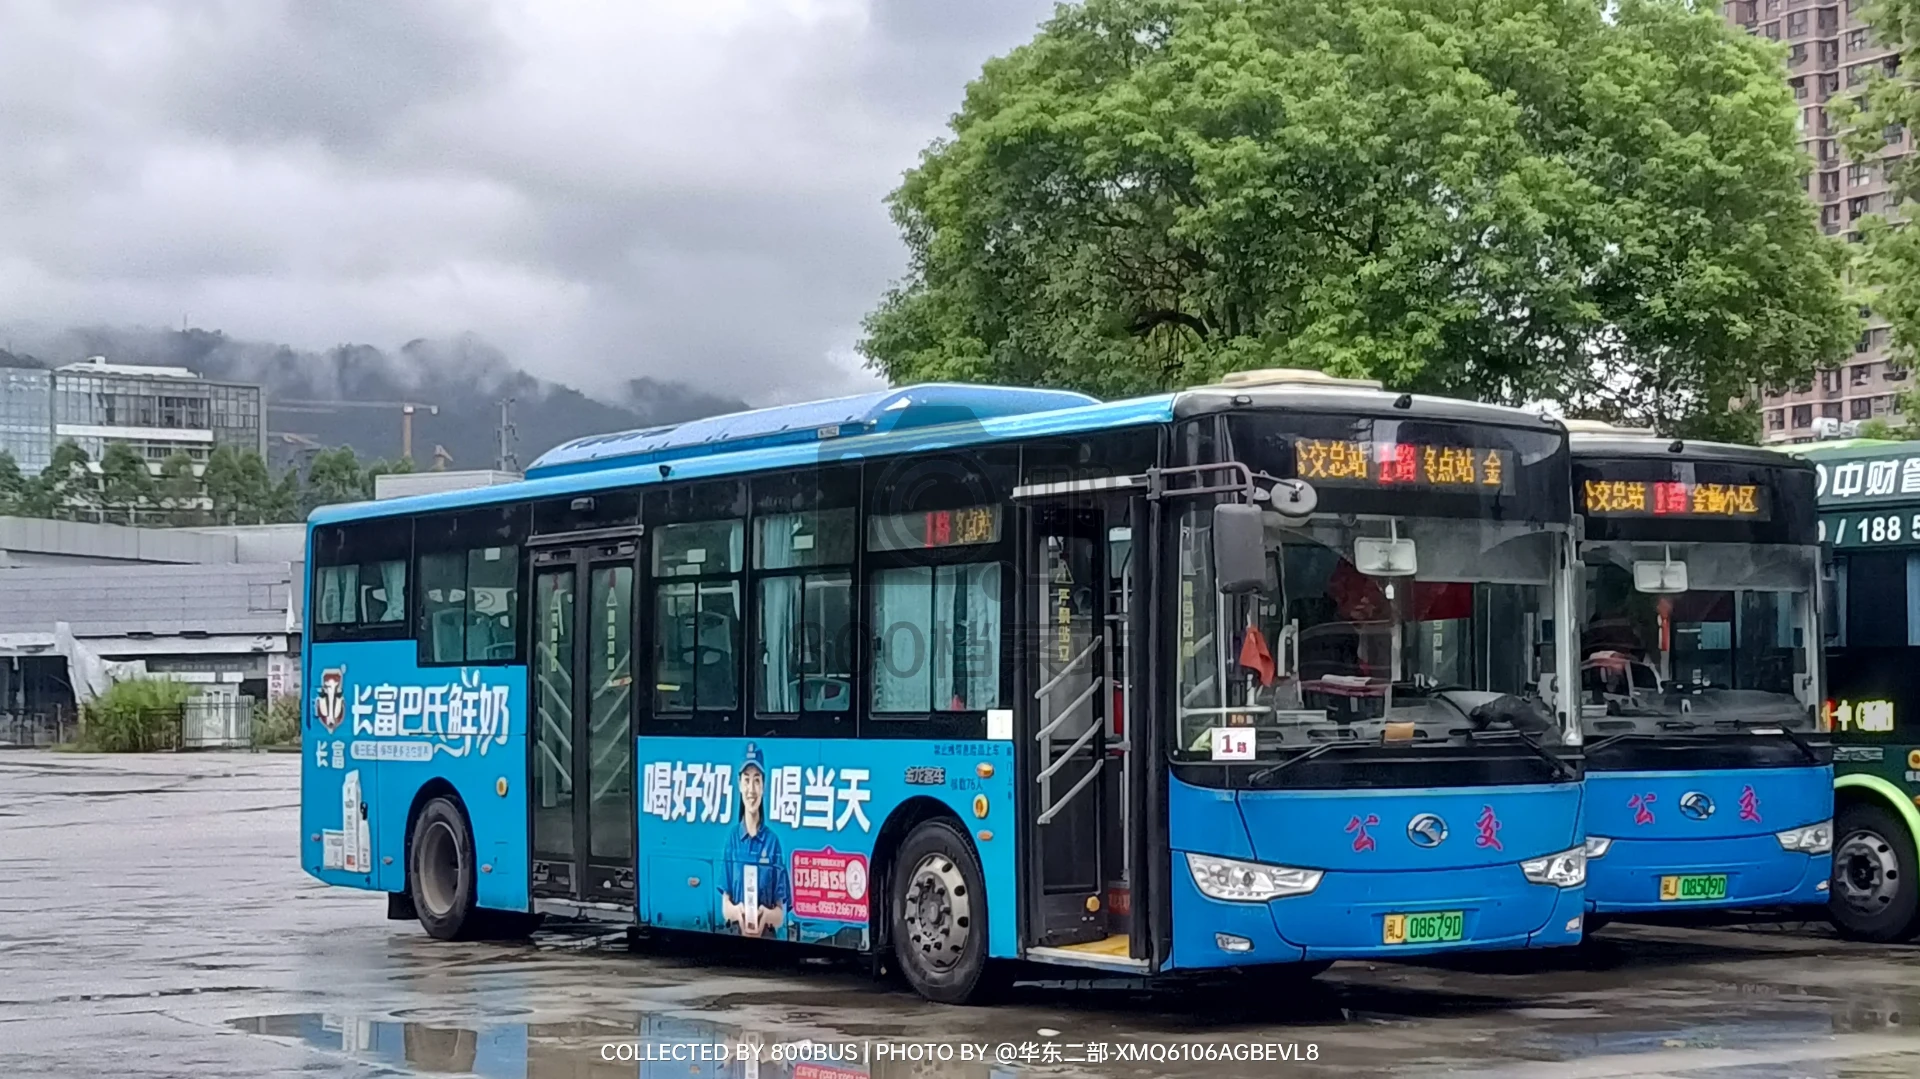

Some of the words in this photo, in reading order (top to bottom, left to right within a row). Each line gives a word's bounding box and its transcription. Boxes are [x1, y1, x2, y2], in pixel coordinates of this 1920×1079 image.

[1379, 443, 1416, 484] 1路
[1483, 448, 1501, 484] 金
[1654, 482, 1687, 515] 1路
[925, 510, 951, 548] 1路
[1857, 516, 1901, 542] 188
[351, 667, 510, 757] 长富巴氏鲜奶
[316, 740, 345, 769] 长富
[643, 761, 732, 824] 喝好奶
[769, 765, 871, 833] 喝当天
[1627, 792, 1657, 825] 公
[1738, 784, 1762, 824] 交
[1345, 815, 1380, 852] 公
[1475, 804, 1503, 851] 交
